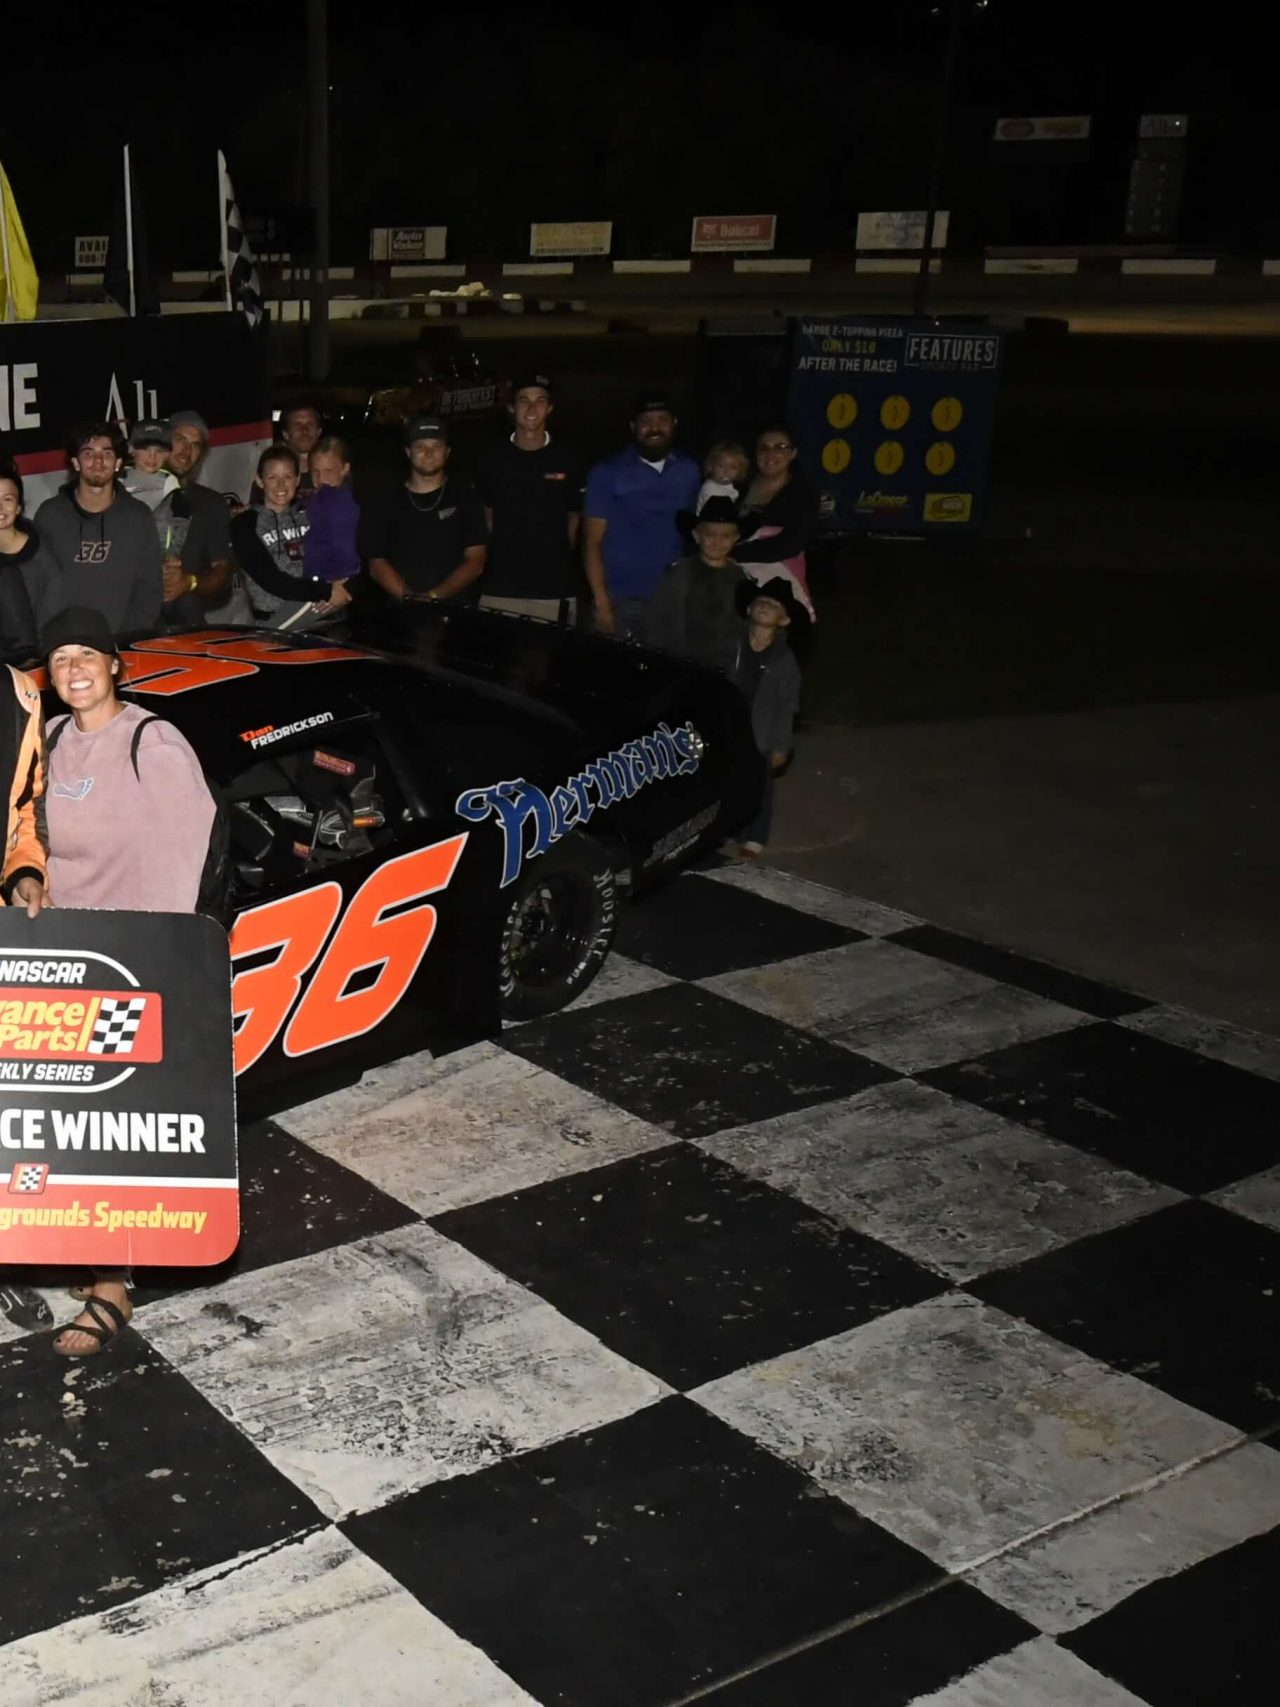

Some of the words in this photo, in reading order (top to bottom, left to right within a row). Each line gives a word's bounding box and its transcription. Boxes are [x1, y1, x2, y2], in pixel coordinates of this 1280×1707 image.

[393, 240, 424, 251] Value
[394, 230, 423, 241] Auto
[909, 337, 996, 363] FEATURES
[798, 355, 838, 371] AFTER
[839, 358, 862, 371] THE
[863, 358, 898, 373] RACE!
[74, 540, 112, 563] 36
[250, 711, 335, 750] FREDRICKSON
[455, 720, 701, 889] Herman's
[230, 831, 470, 1078] 36
[33, 1063, 95, 1083] SERIES
[50, 1109, 207, 1154] WINNER
[93, 1201, 208, 1234] Speedway
